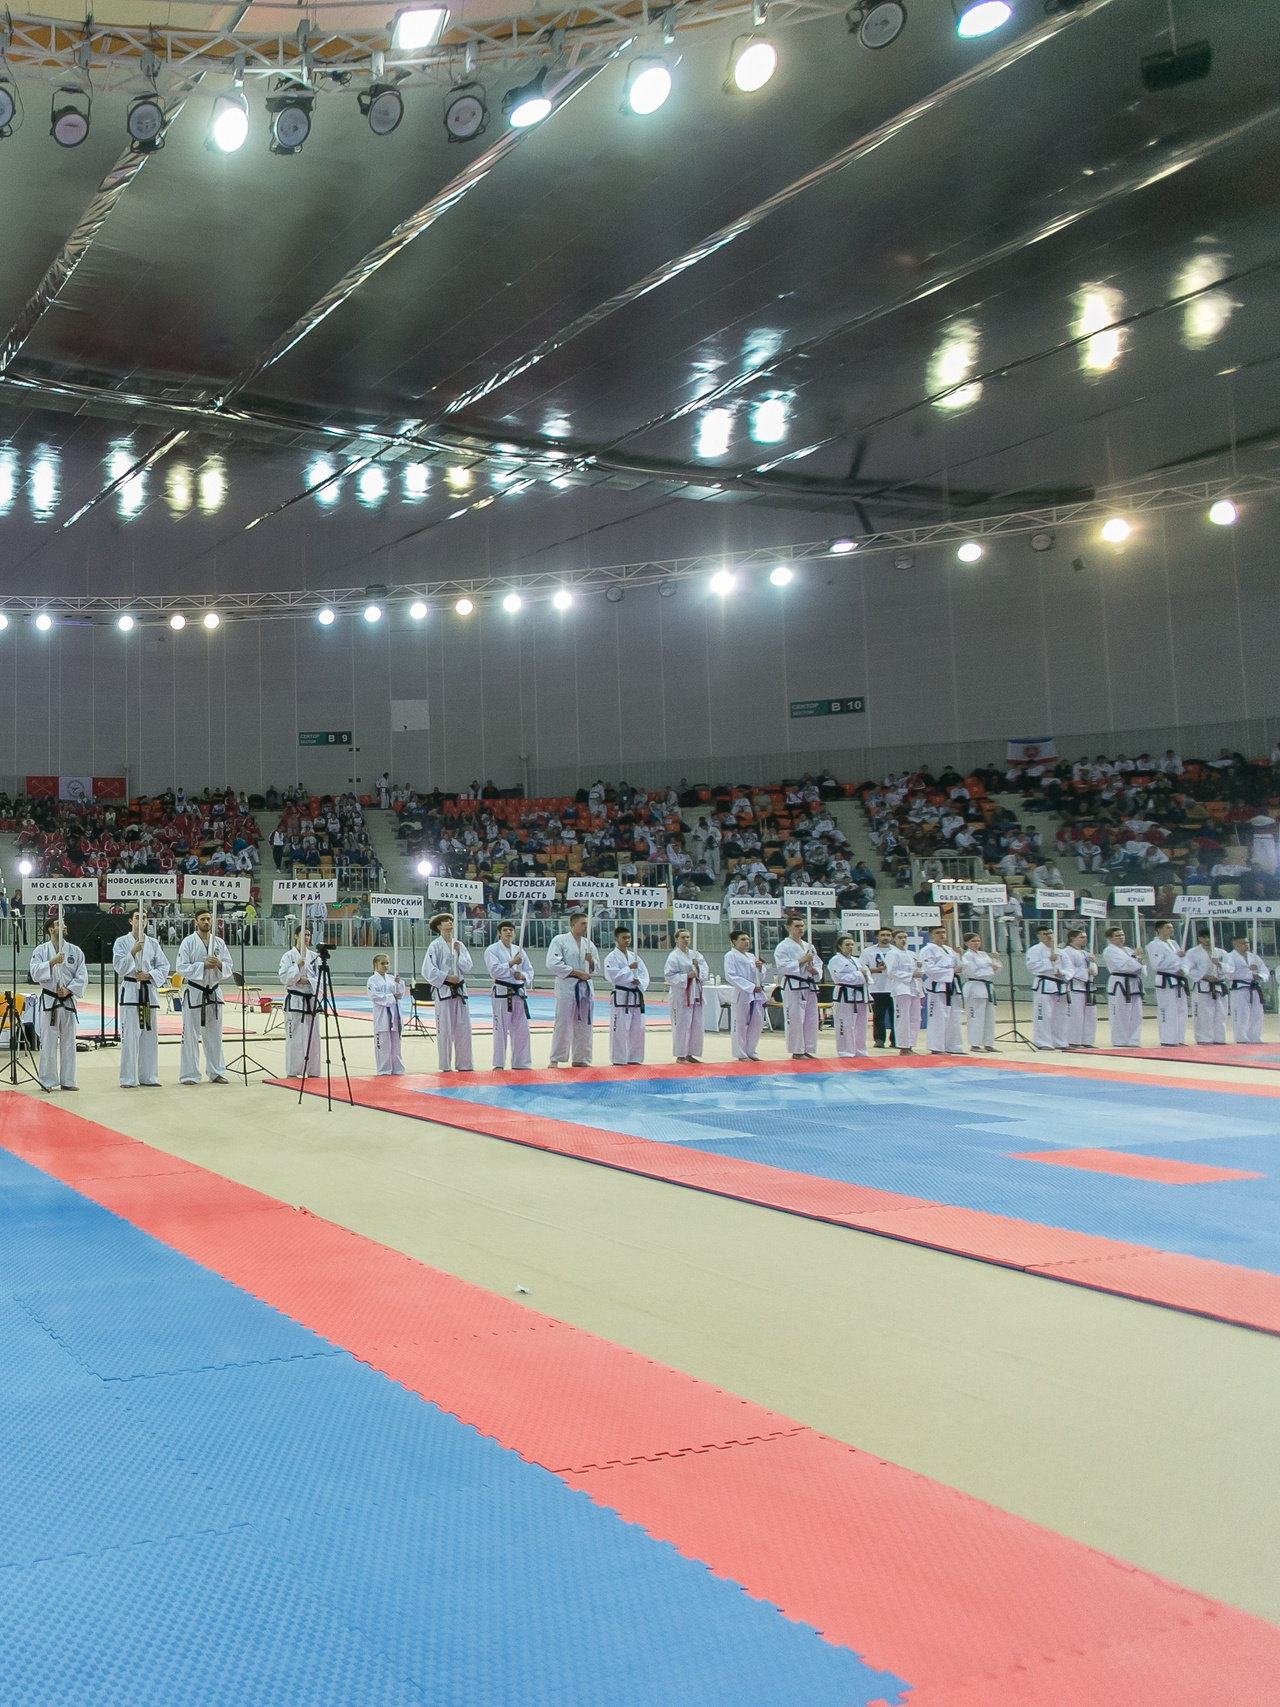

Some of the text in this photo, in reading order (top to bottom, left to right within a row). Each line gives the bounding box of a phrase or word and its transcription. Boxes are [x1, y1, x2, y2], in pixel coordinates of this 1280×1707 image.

[847, 700, 862, 710] 10
[342, 734, 348, 742] 9
[31, 881, 94, 889] МОСКОВСКАЯ
[107, 877, 175, 885] НОВОСИБИРСКАЯ
[191, 878, 241, 888] ОМСКАЯ
[278, 880, 334, 889] ПЕРМСКИЙ
[434, 881, 478, 889] ПСКОВСКАЯ
[502, 879, 556, 887] РОСТОВСКАЯ
[120, 890, 163, 898] ОБЛАСТЬ
[191, 890, 238, 900] ОБЛАСТЬ
[292, 891, 321, 901] КРАЙ
[440, 892, 473, 900] ОБЛАСТЬ
[505, 891, 547, 899] ОБЛАСТЬ
[619, 888, 660, 896] САНКТ-
[36, 894, 83, 902] ОБЛАСТЬ
[371, 896, 423, 906] ПРИМОРСКИЙ
[612, 899, 664, 908] ПЕТЕРБУРГ
[674, 902, 720, 911] САРАТОВСКАЯ
[387, 907, 409, 916] КРАЙ
[681, 913, 711, 921] ОБЛАСТЬ
